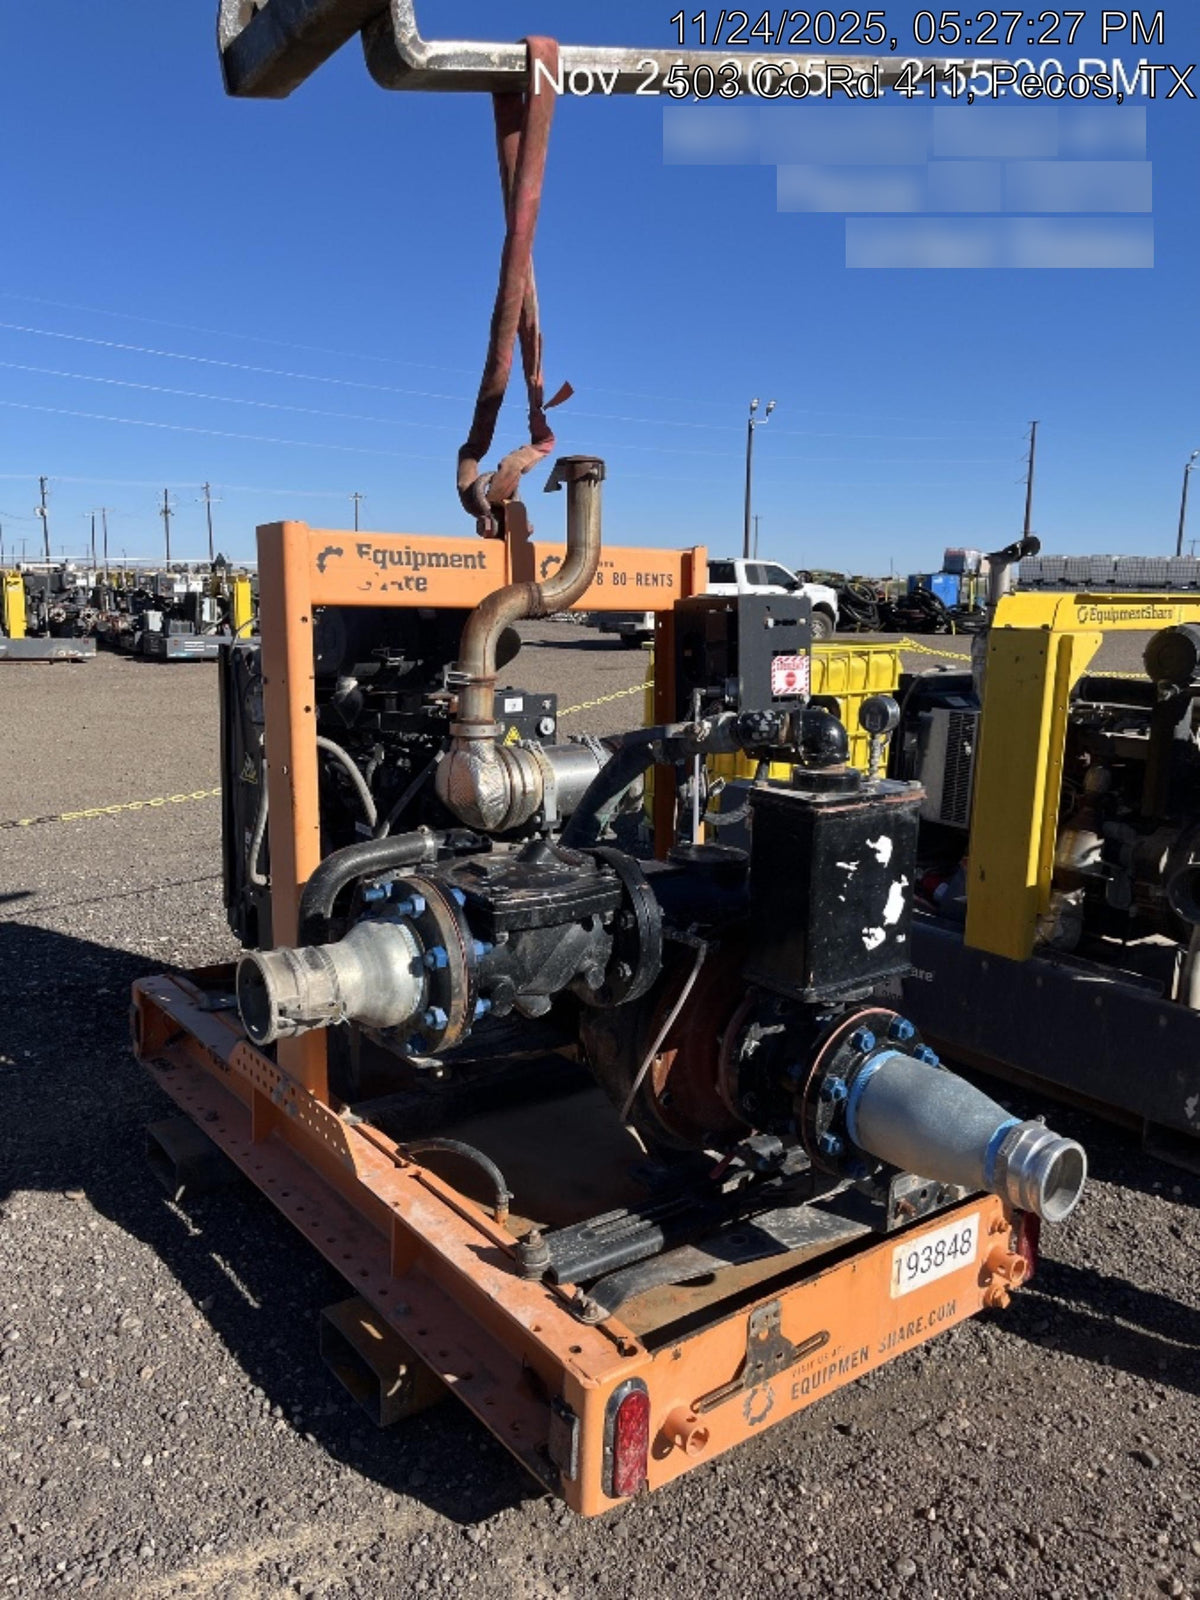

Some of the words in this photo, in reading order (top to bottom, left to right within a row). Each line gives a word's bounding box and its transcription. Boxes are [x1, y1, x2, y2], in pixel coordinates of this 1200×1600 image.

[355, 543, 487, 570] Equipment
[910, 966, 934, 982] are
[894, 1228, 972, 1285] 193848
